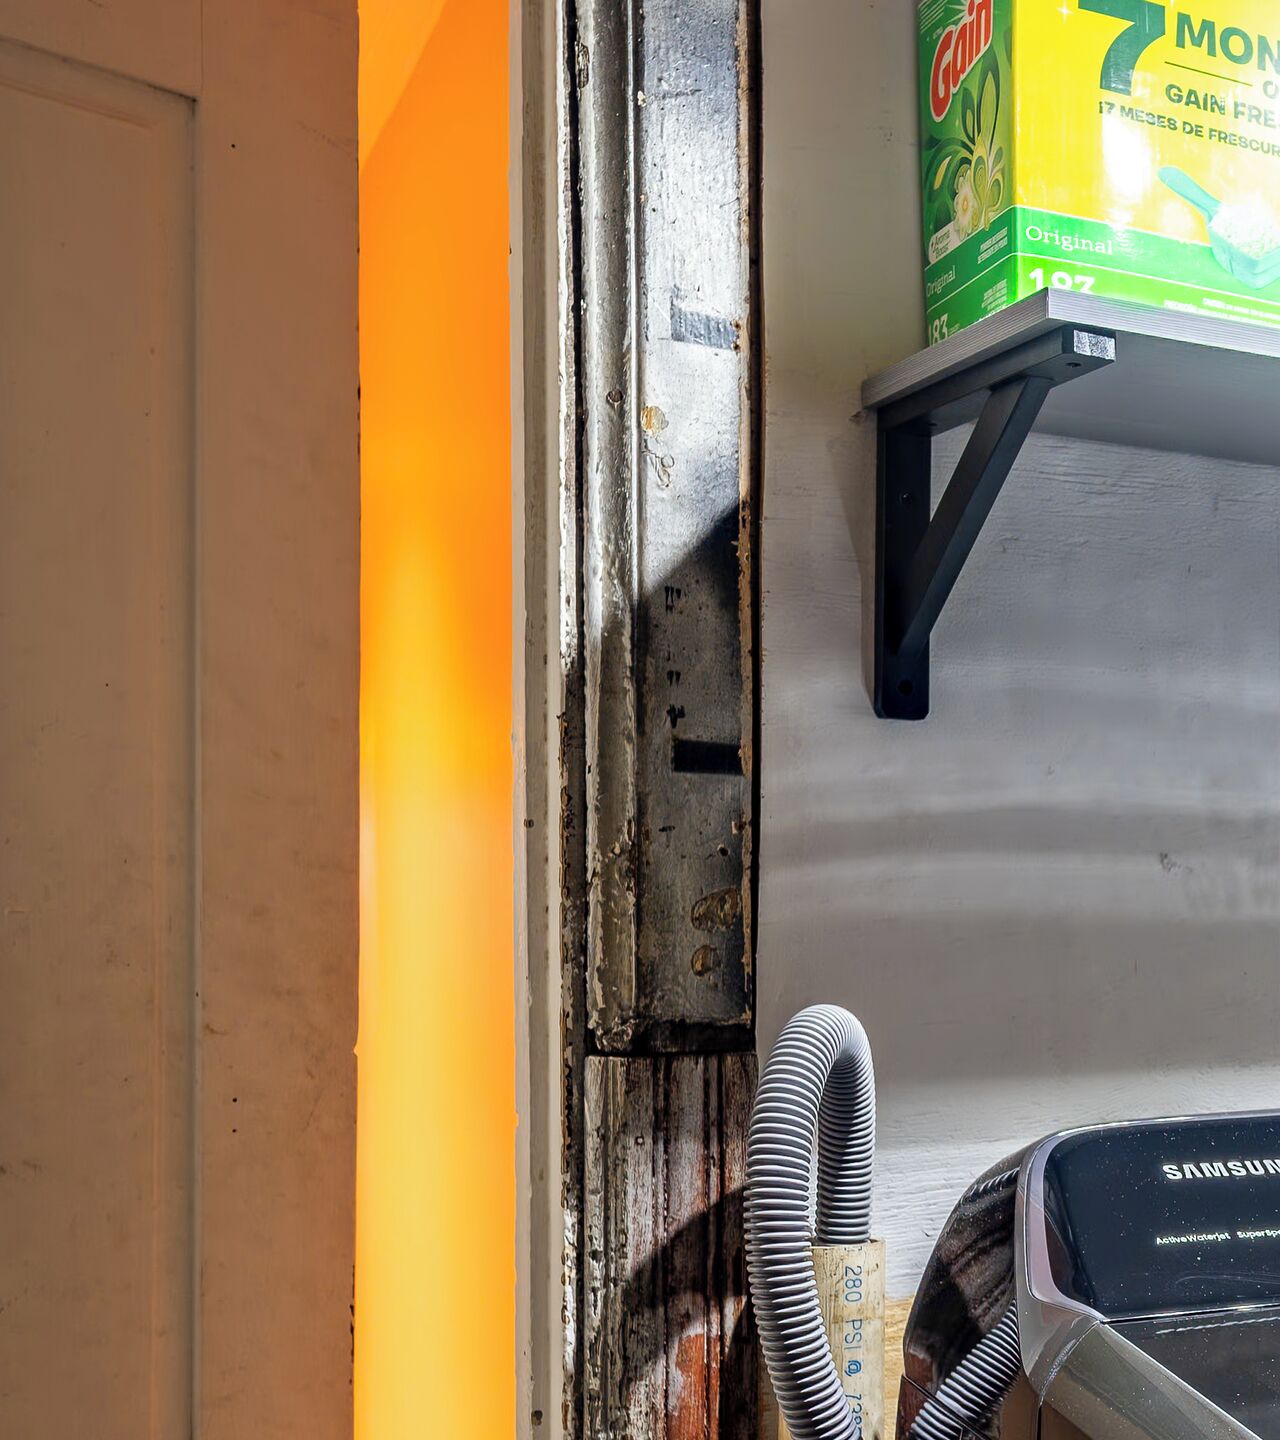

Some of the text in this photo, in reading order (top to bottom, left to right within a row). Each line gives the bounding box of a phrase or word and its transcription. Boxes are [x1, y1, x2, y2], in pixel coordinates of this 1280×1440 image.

[930, 0, 993, 122] Gain
[1077, 0, 1166, 96] 7
[1165, 83, 1226, 116] GAIN
[1120, 104, 1179, 132] MESES
[1182, 120, 1205, 138] DE
[1025, 225, 1114, 256] Original
[926, 264, 957, 298] Original
[844, 1265, 863, 1303] 280
[844, 1318, 863, 1350] PSI
[843, 1359, 864, 1377] @
